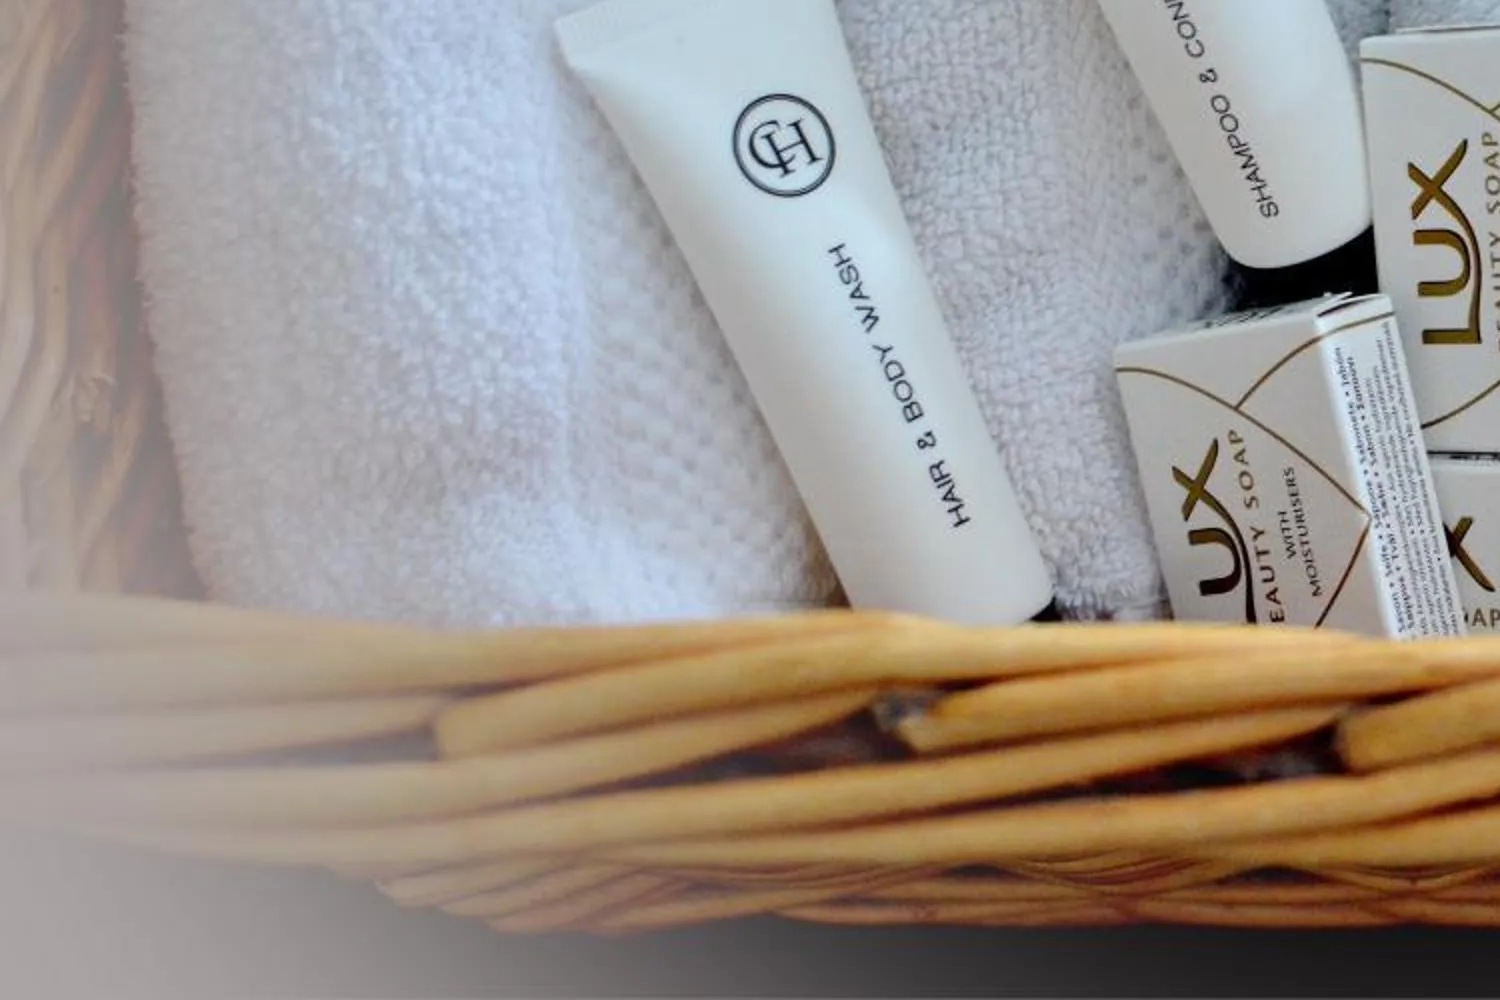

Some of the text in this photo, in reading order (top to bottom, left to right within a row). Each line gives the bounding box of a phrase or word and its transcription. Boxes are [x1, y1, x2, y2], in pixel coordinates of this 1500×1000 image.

[1199, 68, 1218, 85] &
[1211, 94, 1280, 219] SHAMPOO
[1407, 137, 1482, 344] LUX
[828, 242, 972, 529] HAIR & BODY WASH
[1171, 437, 1257, 624] UX
[1227, 428, 1286, 624] EAUTY SOAP
[1277, 510, 1297, 560] WITH
[1283, 466, 1323, 598] MOISTURISERS
